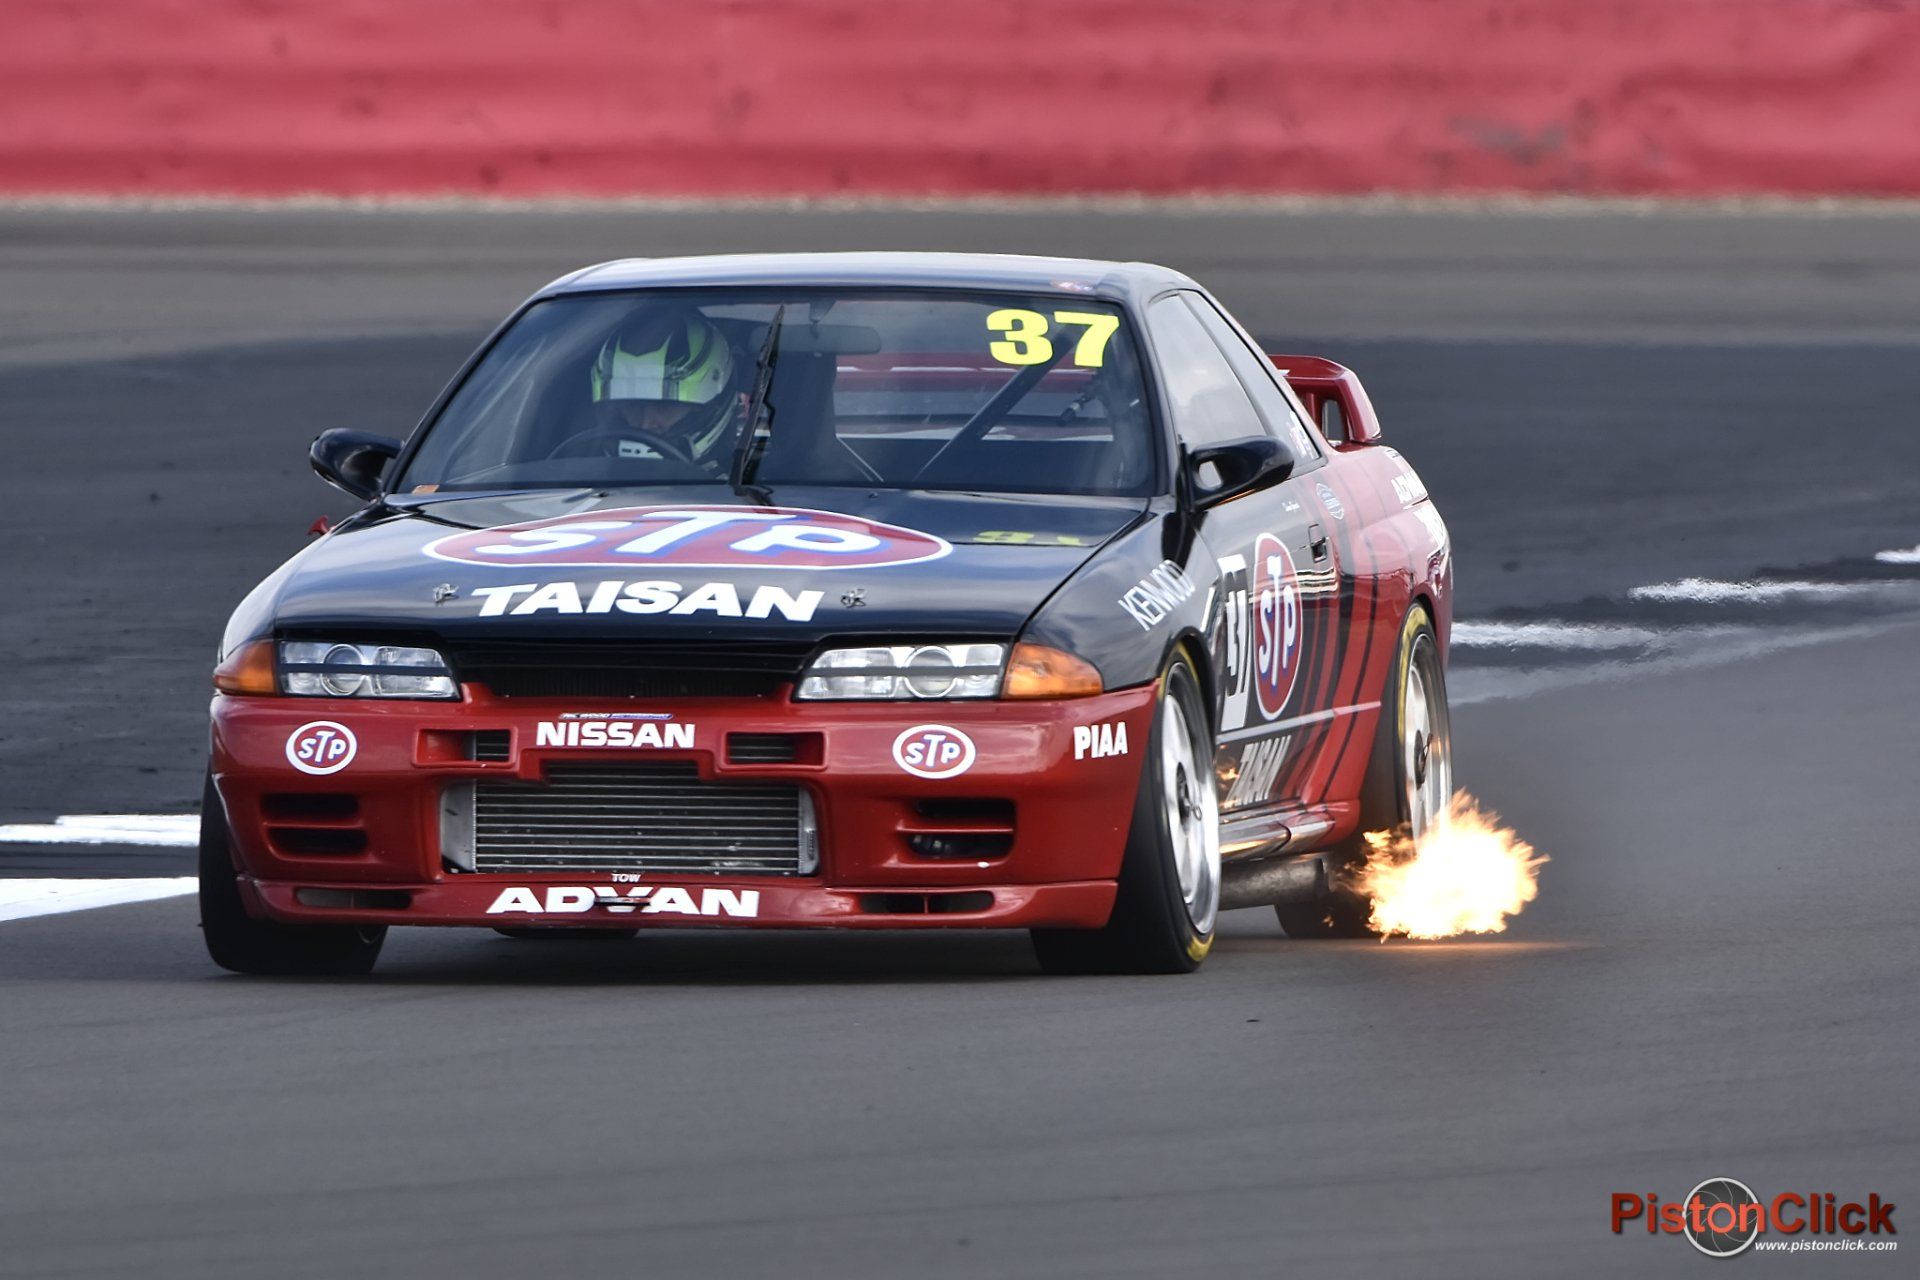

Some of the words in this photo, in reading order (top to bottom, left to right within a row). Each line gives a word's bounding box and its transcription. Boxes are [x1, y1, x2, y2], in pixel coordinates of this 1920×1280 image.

[986, 309, 1119, 368] 37
[475, 511, 888, 556] STP
[471, 580, 825, 622] TAISAN
[1259, 555, 1297, 688] STP
[297, 730, 347, 764] STP
[536, 721, 696, 748] NISSAN
[905, 734, 961, 768] STP
[1073, 721, 1129, 760] PIAA
[611, 873, 642, 883] TOW
[486, 886, 760, 917] ADVAN
